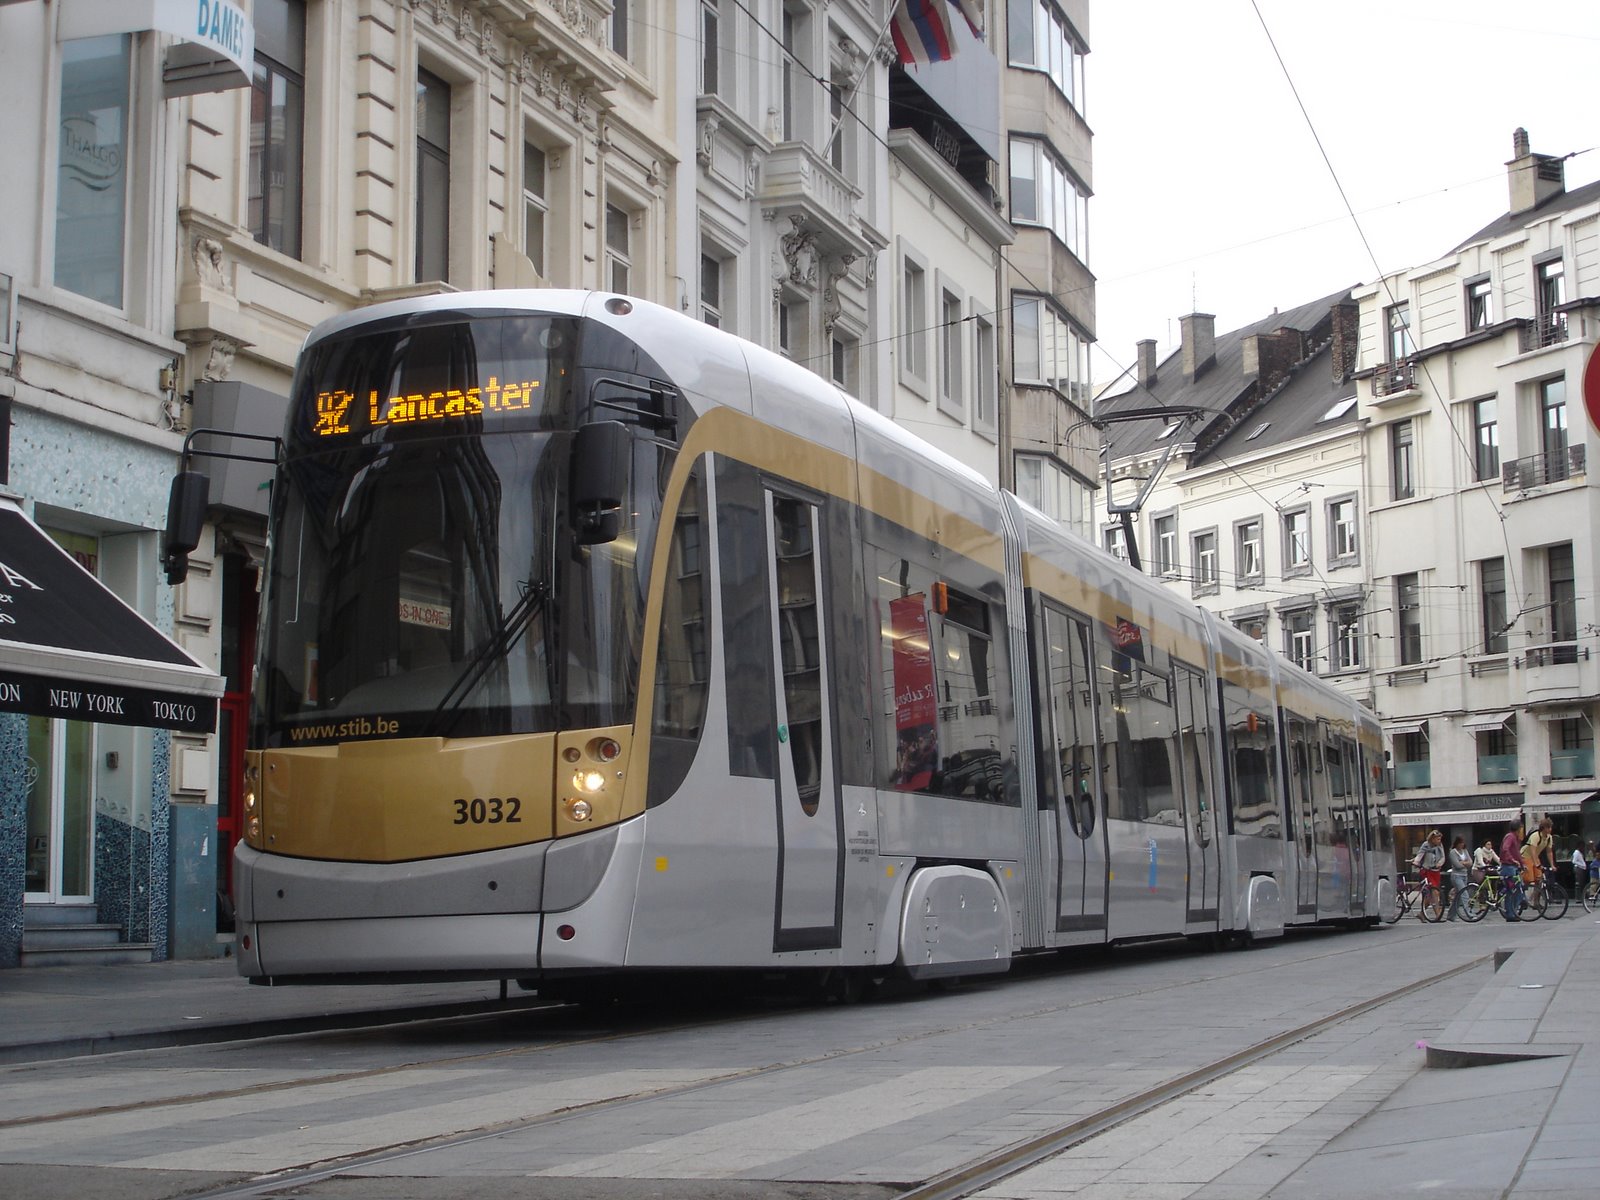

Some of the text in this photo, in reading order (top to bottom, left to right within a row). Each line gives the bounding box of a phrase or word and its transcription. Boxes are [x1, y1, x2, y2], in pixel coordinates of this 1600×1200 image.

[198, 0, 244, 59] DAMES
[62, 125, 118, 168] THALGO
[369, 377, 540, 425] Lancaster
[50, 688, 82, 709] NEW
[87, 693, 125, 715] YORK
[153, 700, 196, 722] TOKYO
[290, 716, 399, 741] www.stib.be
[453, 797, 522, 825] 3032
